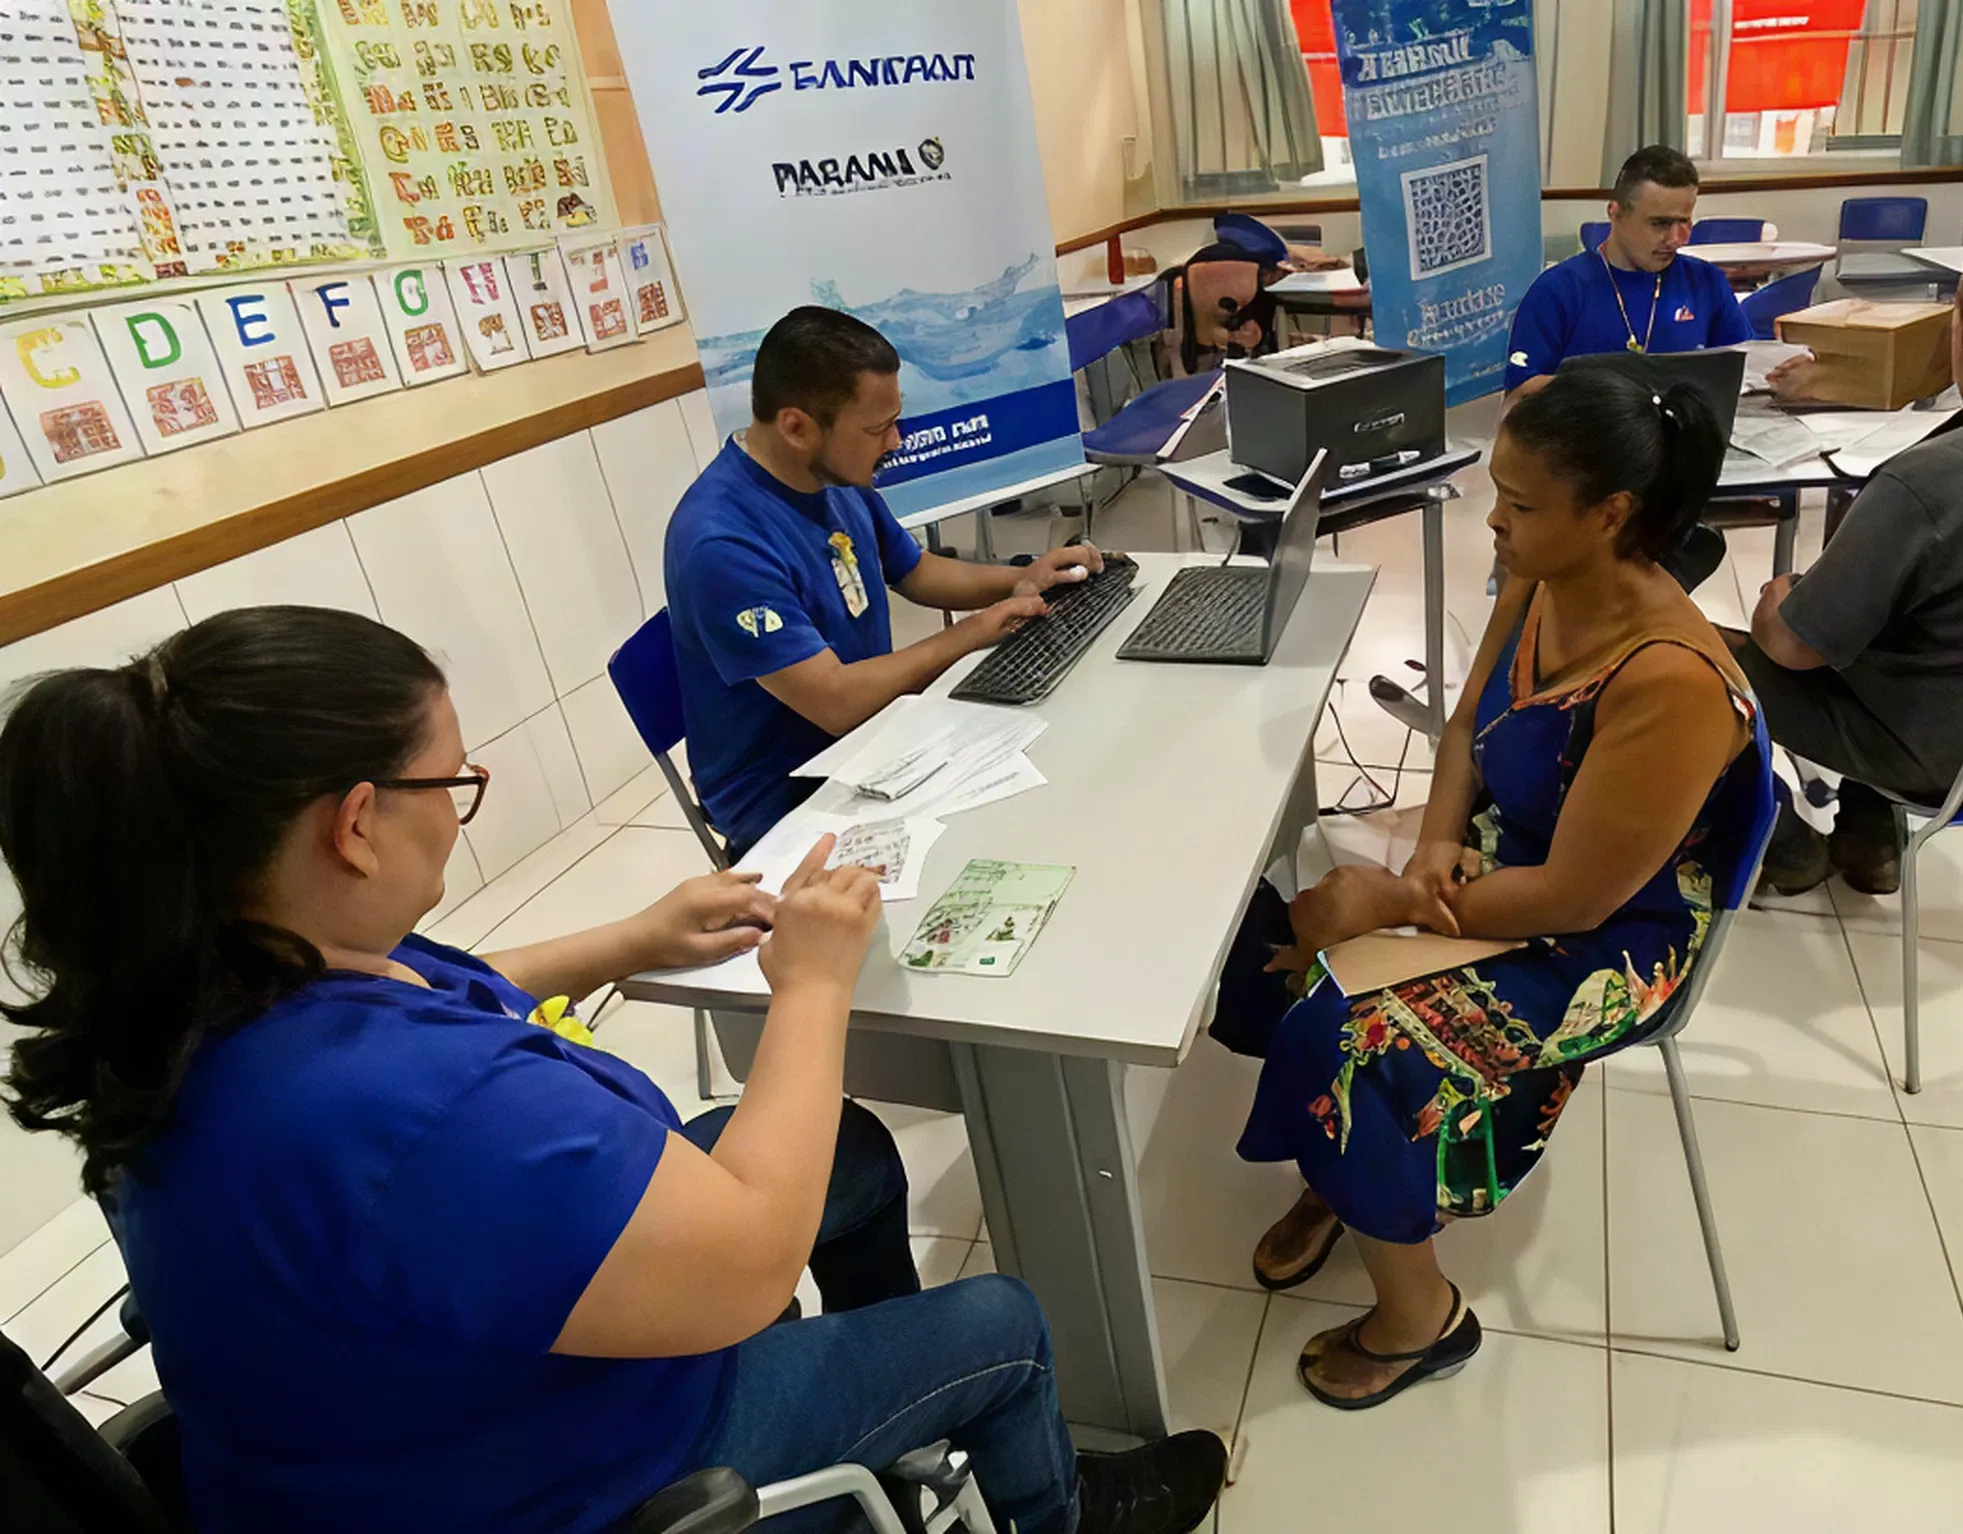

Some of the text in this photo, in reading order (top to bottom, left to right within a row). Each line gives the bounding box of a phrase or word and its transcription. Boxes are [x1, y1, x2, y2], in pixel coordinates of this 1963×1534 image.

[15, 327, 80, 389] C
[125, 312, 182, 369] D
[225, 295, 275, 347] E
[316, 281, 350, 327] F
